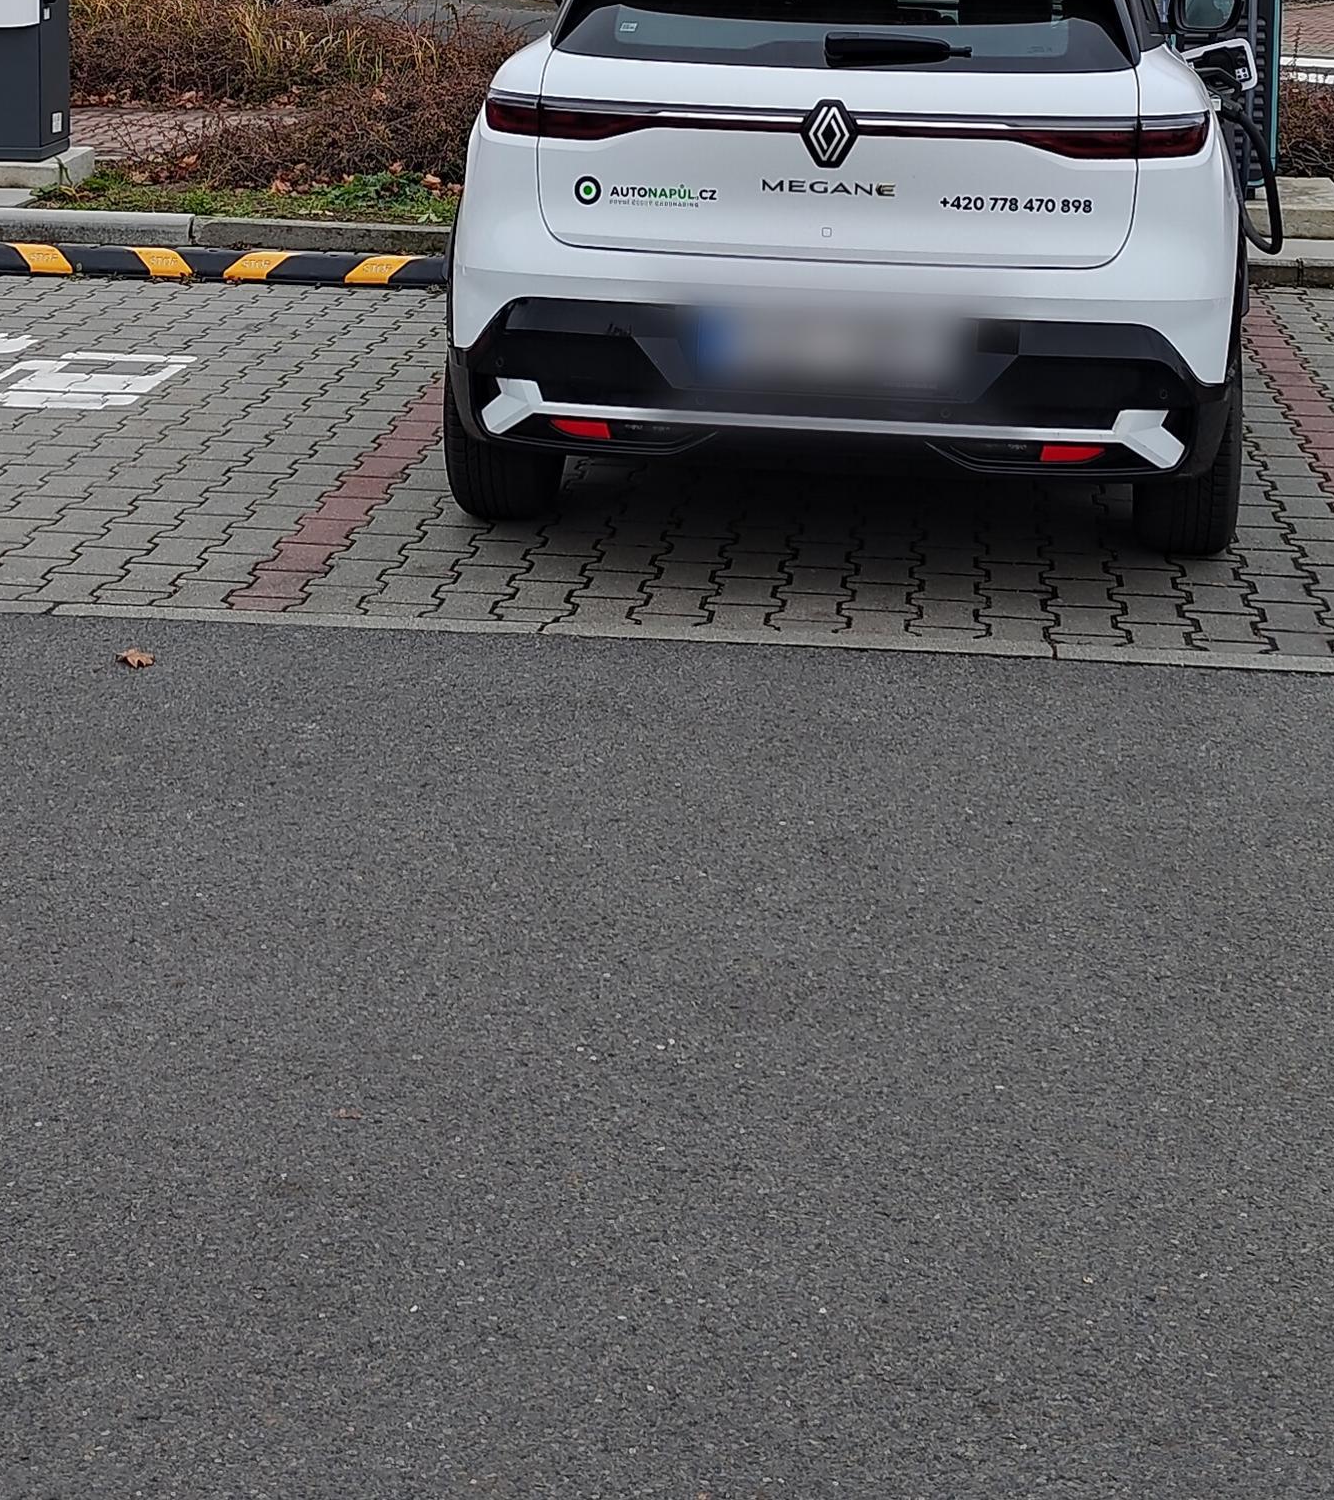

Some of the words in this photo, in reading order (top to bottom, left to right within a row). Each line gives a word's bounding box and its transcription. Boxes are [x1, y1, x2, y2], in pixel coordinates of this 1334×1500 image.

[610, 184, 717, 201] AUTONAPŮL.CZ
[762, 179, 896, 197] MEGANE
[940, 196, 985, 211] +420
[989, 197, 1019, 211] 778
[1023, 198, 1056, 213] 470
[1060, 199, 1093, 213] 898
